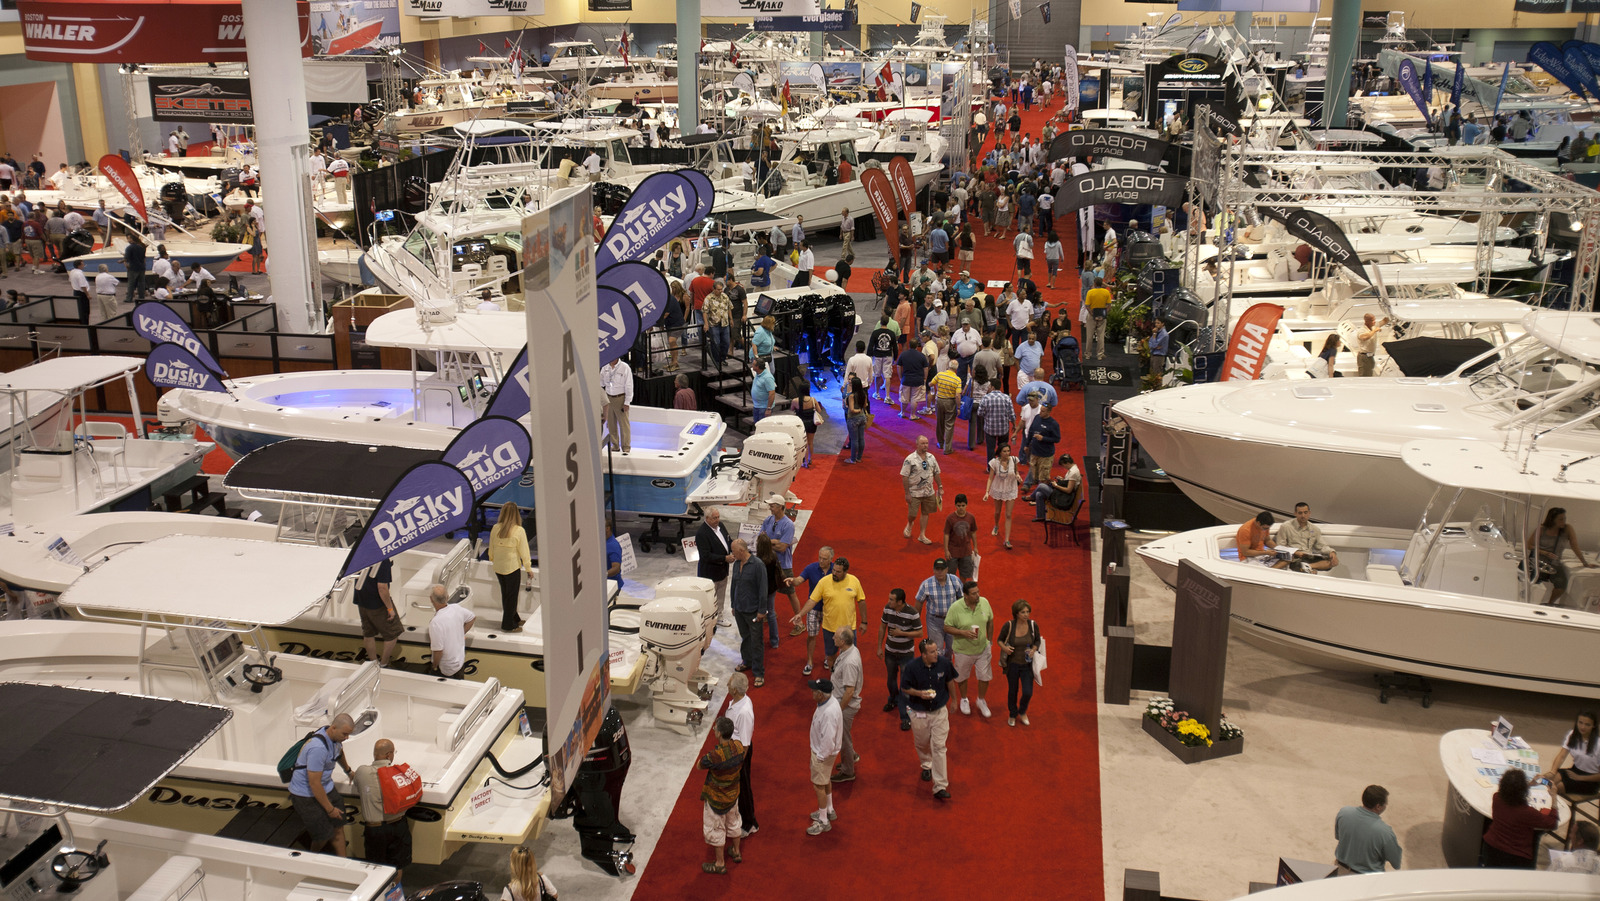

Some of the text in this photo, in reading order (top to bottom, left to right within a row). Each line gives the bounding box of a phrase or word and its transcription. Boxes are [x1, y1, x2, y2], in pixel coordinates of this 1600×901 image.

[420, 0, 442, 11] MAKO
[503, 0, 527, 11] MAKO
[756, 0, 783, 12] MAKO
[24, 13, 44, 21] BOSTON
[802, 12, 843, 23] Everglades
[25, 23, 96, 41] WHALER
[1533, 47, 1570, 77] EdgeWater
[1565, 53, 1593, 81] EdgeWater
[1066, 62, 1076, 105] REGULATOR
[155, 97, 251, 110] SKEETER
[605, 184, 687, 260] Dusky
[618, 211, 675, 262] FACTORY DIRECT
[1228, 322, 1269, 381] MAHA
[153, 362, 209, 389] Dusky
[153, 377, 196, 388] FACTORY DIRECT
[748, 449, 784, 461] EVINRUDE
[1111, 427, 1126, 477] BALO
[561, 329, 584, 600] AISLE
[372, 485, 464, 549] Dusky
[382, 513, 449, 555] FACTORY DIRECT
[1181, 578, 1220, 605] JUPITER
[645, 620, 687, 632] EVINRUDE
[608, 650, 624, 658] ACTORY
[148, 786, 280, 810] Dusk
[470, 789, 492, 802] FACTORY
[474, 798, 491, 809] DIRECT
